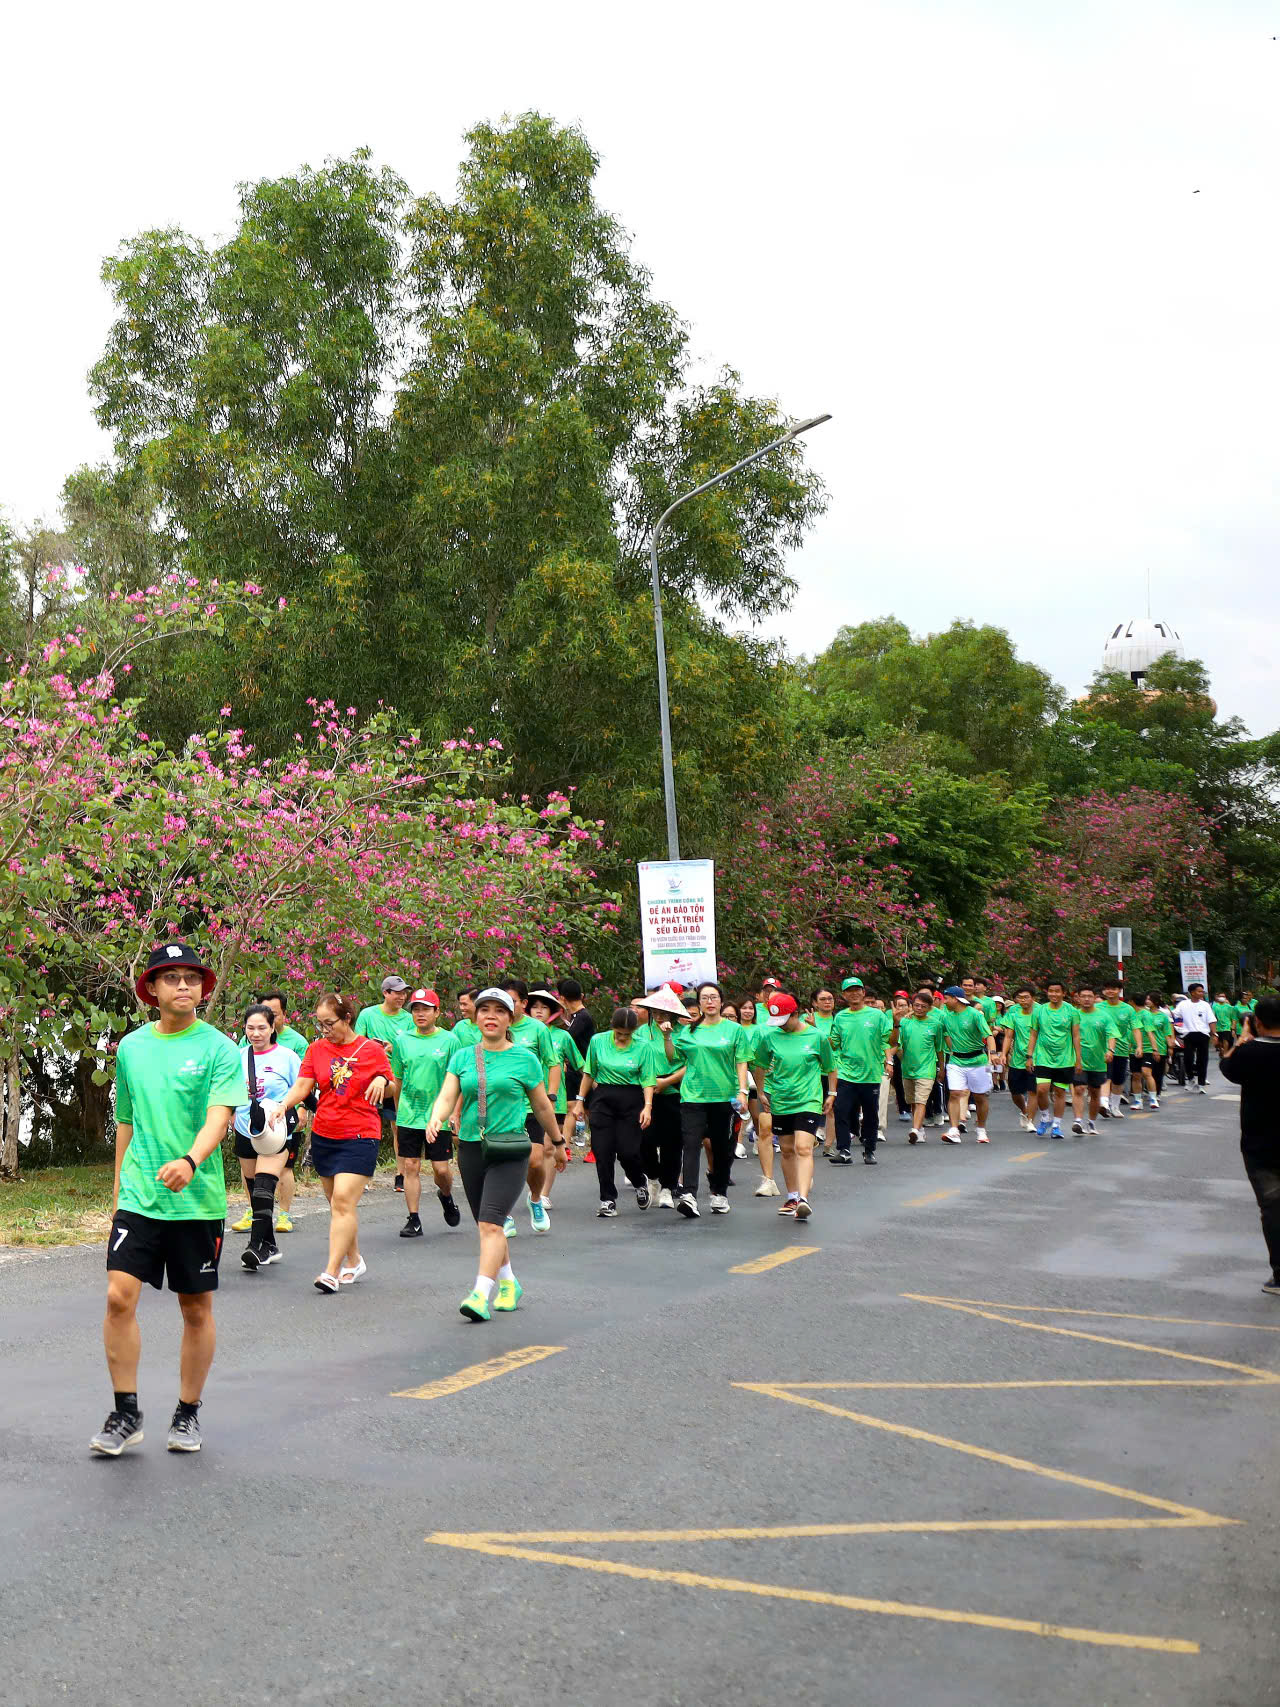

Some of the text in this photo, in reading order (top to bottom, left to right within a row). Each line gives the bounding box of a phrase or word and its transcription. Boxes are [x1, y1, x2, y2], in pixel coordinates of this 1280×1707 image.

[649, 903, 705, 914] ĐỀ ÁN BẢO TỒN
[648, 913, 704, 925] VÀ PHÁT TRIỂN
[656, 924, 701, 935] SẾU ĐẦU ĐỎ
[113, 1227, 129, 1252] 7
